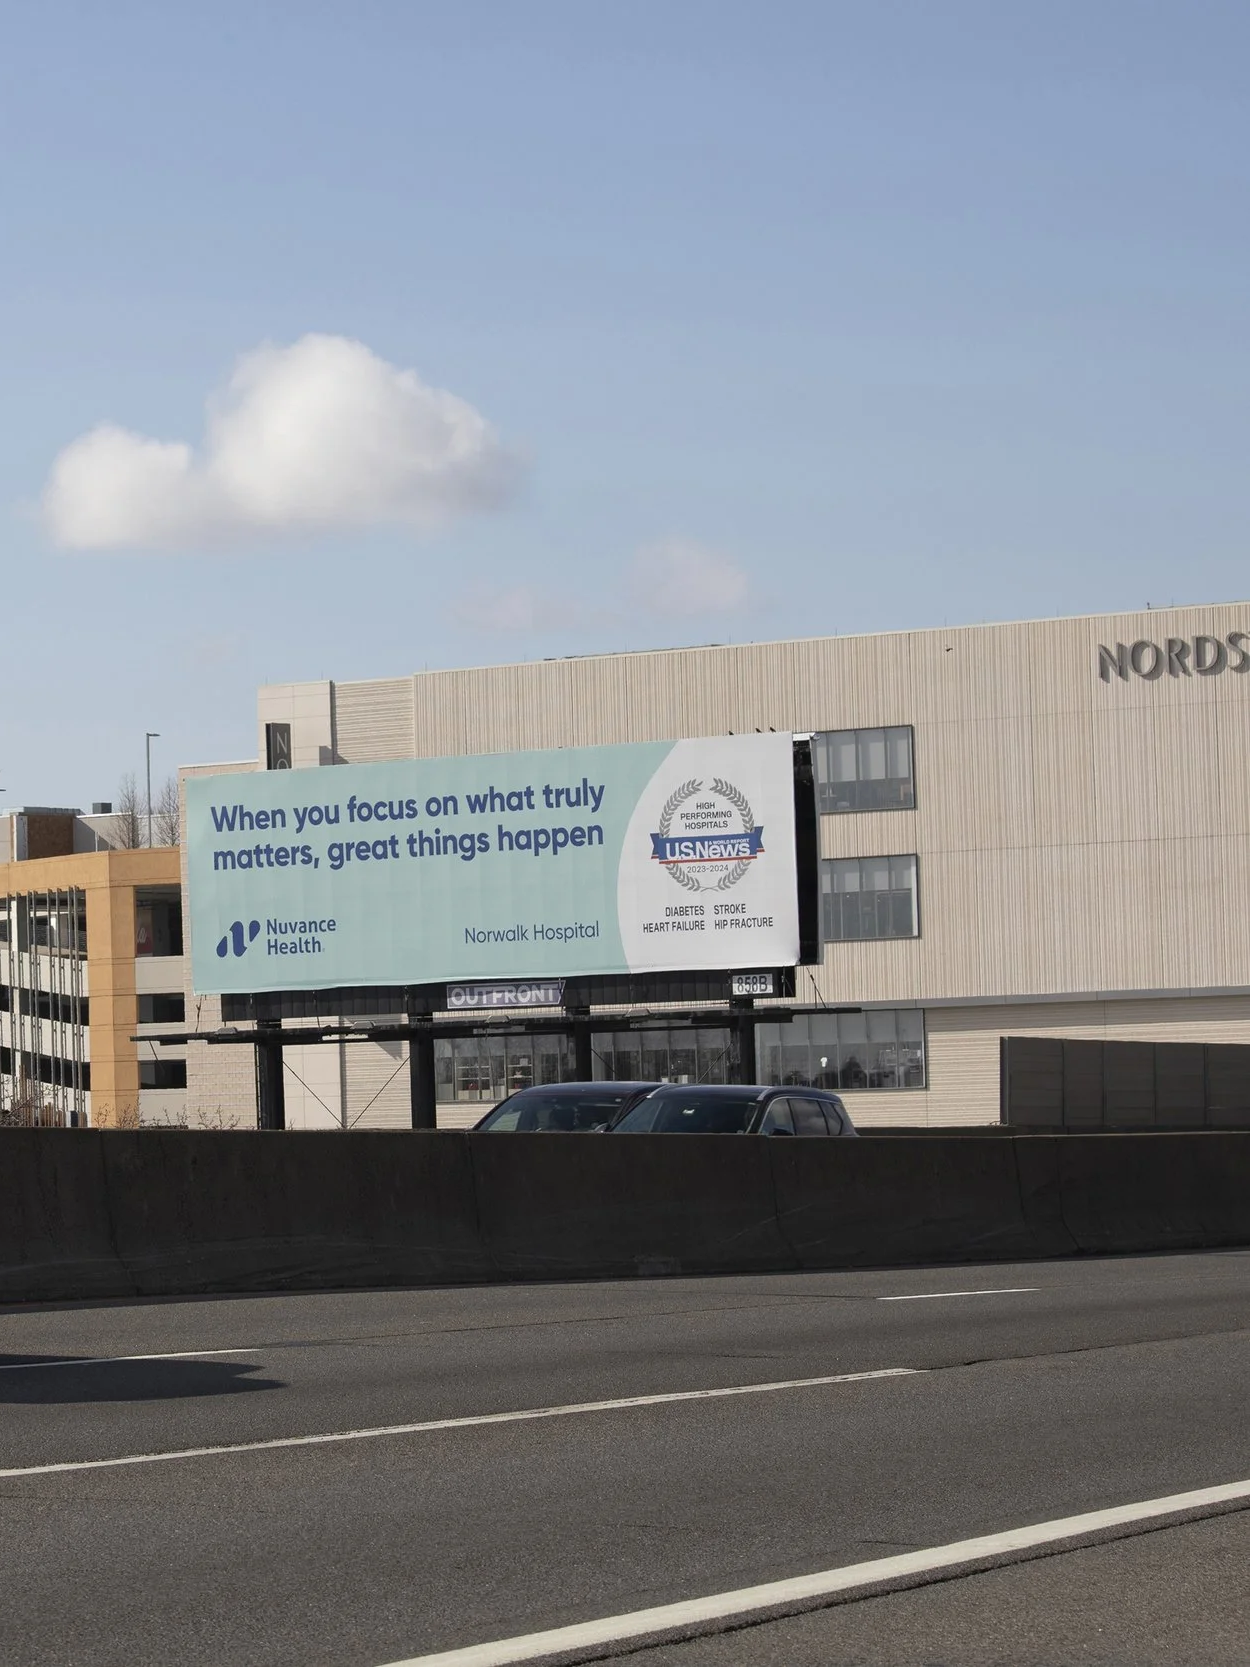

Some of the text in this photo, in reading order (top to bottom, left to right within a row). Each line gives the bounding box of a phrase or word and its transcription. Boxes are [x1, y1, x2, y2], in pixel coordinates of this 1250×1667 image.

[211, 778, 605, 834] When you focus on what truly
[696, 802, 716, 810] HIGH
[680, 810, 732, 820] PERFORMING
[685, 821, 728, 830] HOSPITALS
[213, 824, 604, 871] matters, great things happen
[687, 864, 729, 873] 2023-2024
[665, 903, 746, 917] DIABETES STROKE
[266, 919, 337, 935] Nuvance
[465, 920, 600, 944] Norwalk Hospital
[643, 917, 773, 933] HEART FAILURE HIP FRACTURE
[267, 936, 322, 955] Health
[737, 975, 768, 993] 858B
[451, 983, 558, 1005] OUTFRONT
